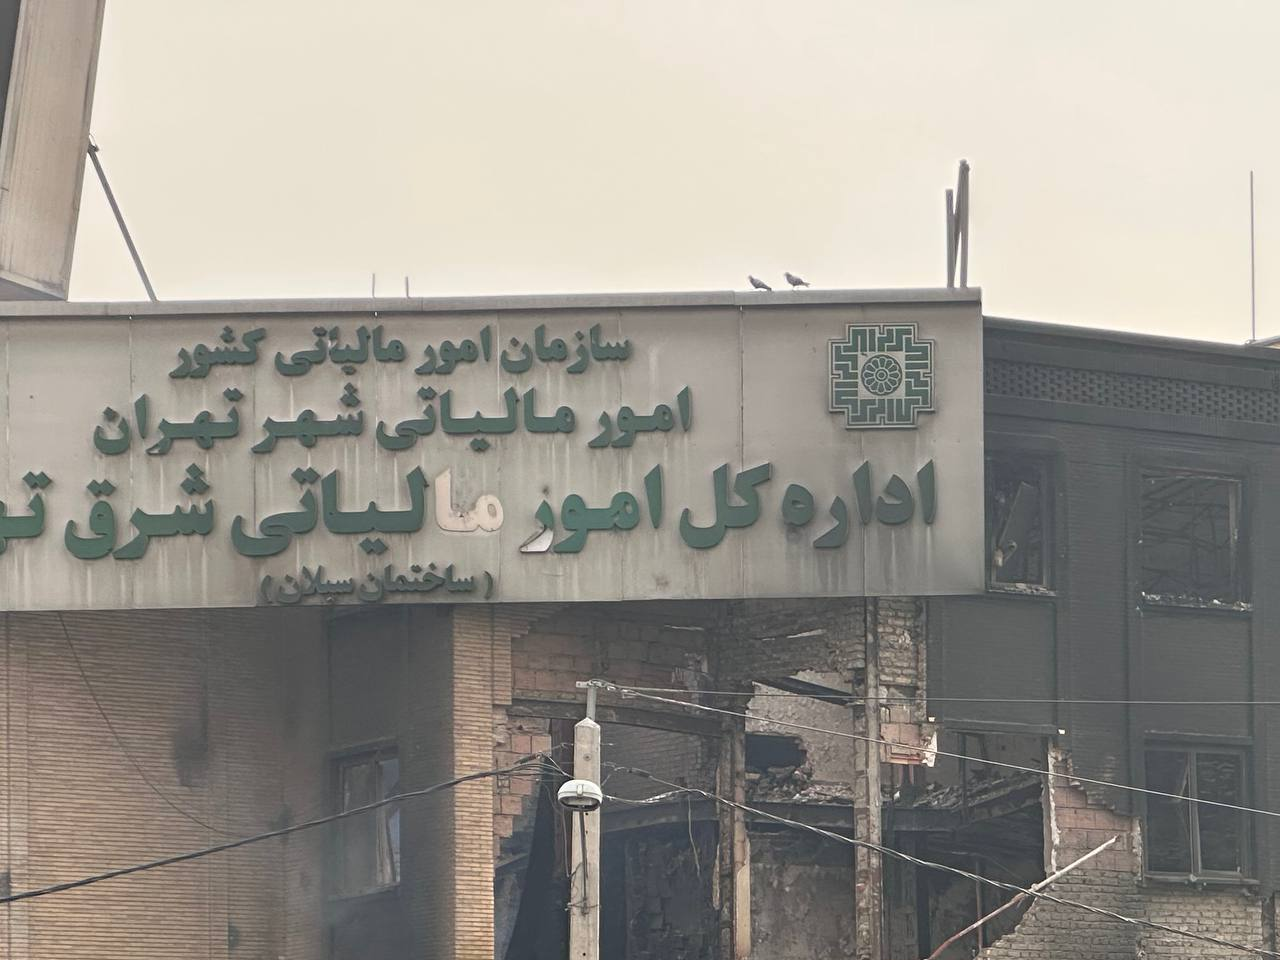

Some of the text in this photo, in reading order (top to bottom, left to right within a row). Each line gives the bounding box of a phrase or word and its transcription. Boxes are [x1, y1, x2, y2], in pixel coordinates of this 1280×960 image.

[168, 323, 633, 379] سازمان امور مالیاتی کشور
[93, 382, 693, 456] امور مالیاتی شهر تهران
[64, 462, 215, 560] شرق
[230, 465, 505, 557] مالیاتی
[518, 463, 665, 553] امور
[679, 462, 773, 549] کل
[781, 458, 937, 549] اداره
